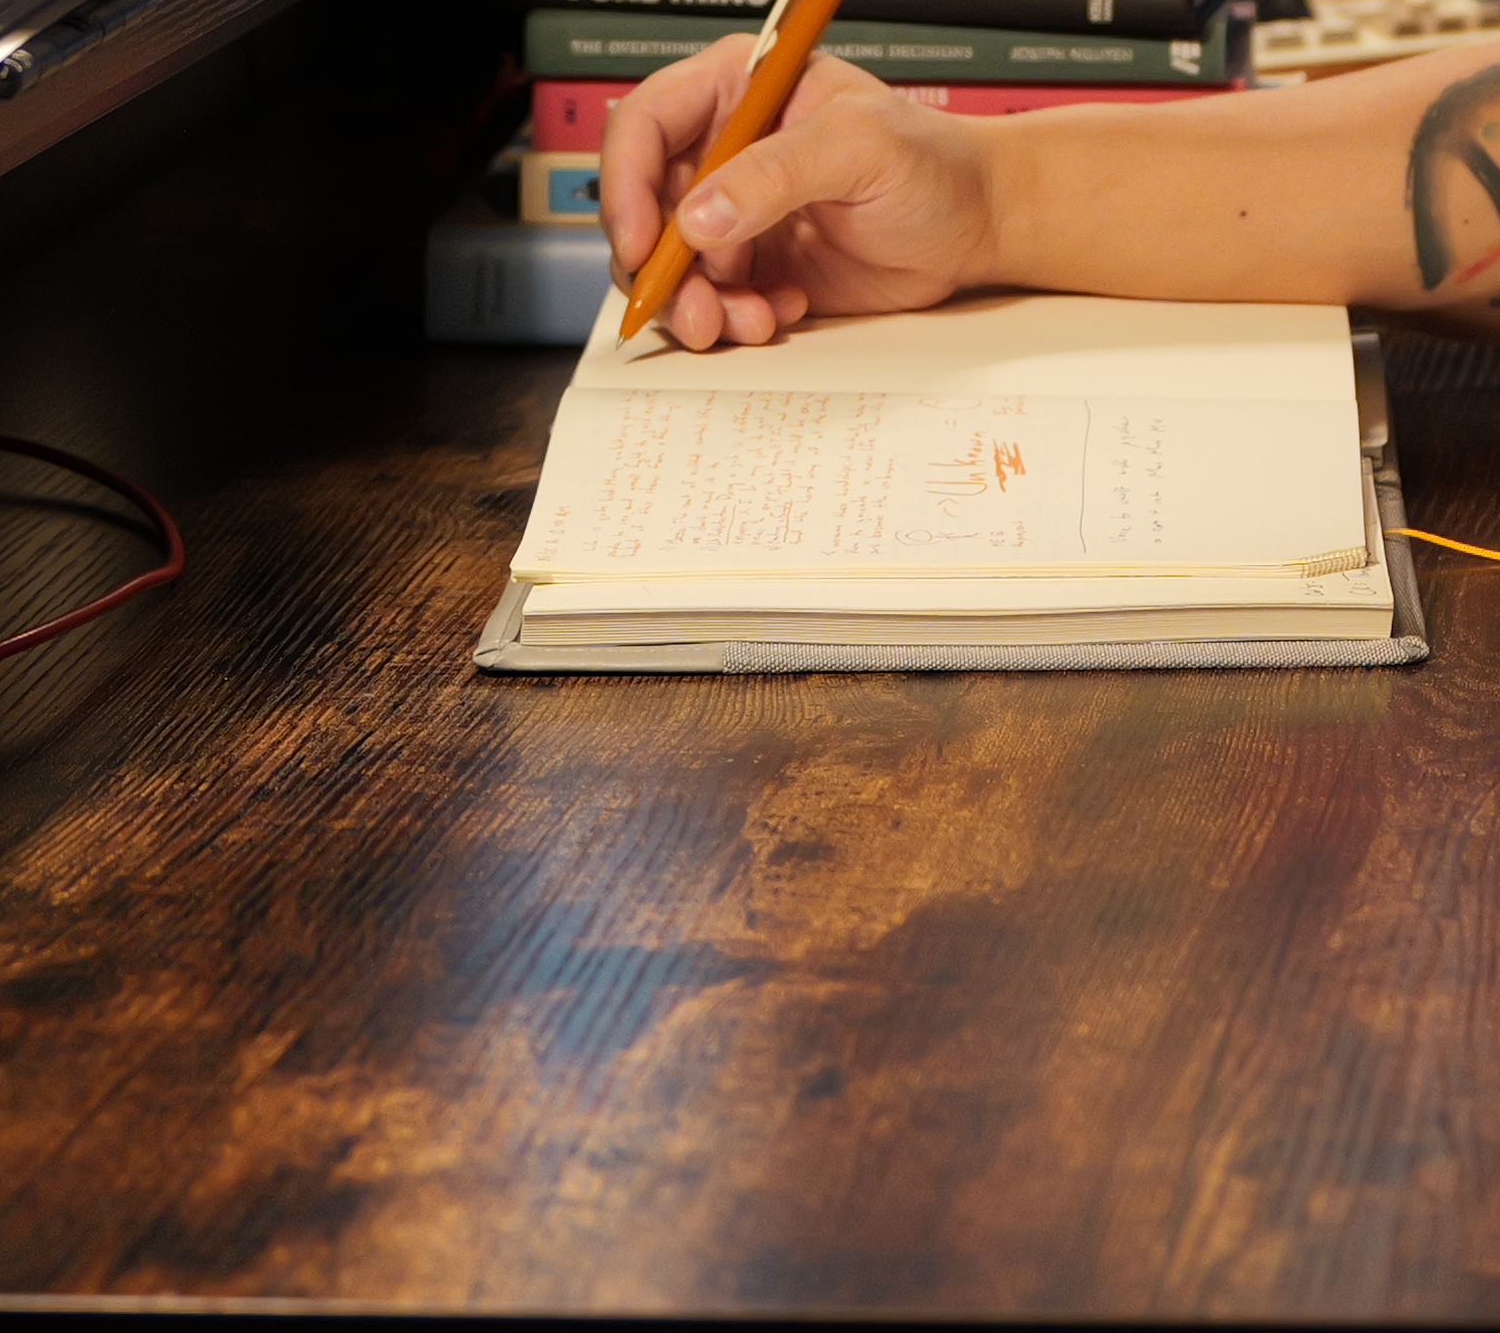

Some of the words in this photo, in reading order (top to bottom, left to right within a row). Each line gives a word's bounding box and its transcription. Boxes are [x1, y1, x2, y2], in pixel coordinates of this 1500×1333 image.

[570, 41, 604, 55] THE
[888, 45, 974, 61] DECISIONS
[1010, 46, 1067, 62] JOSEPH
[1072, 47, 1133, 63] NGUYEN
